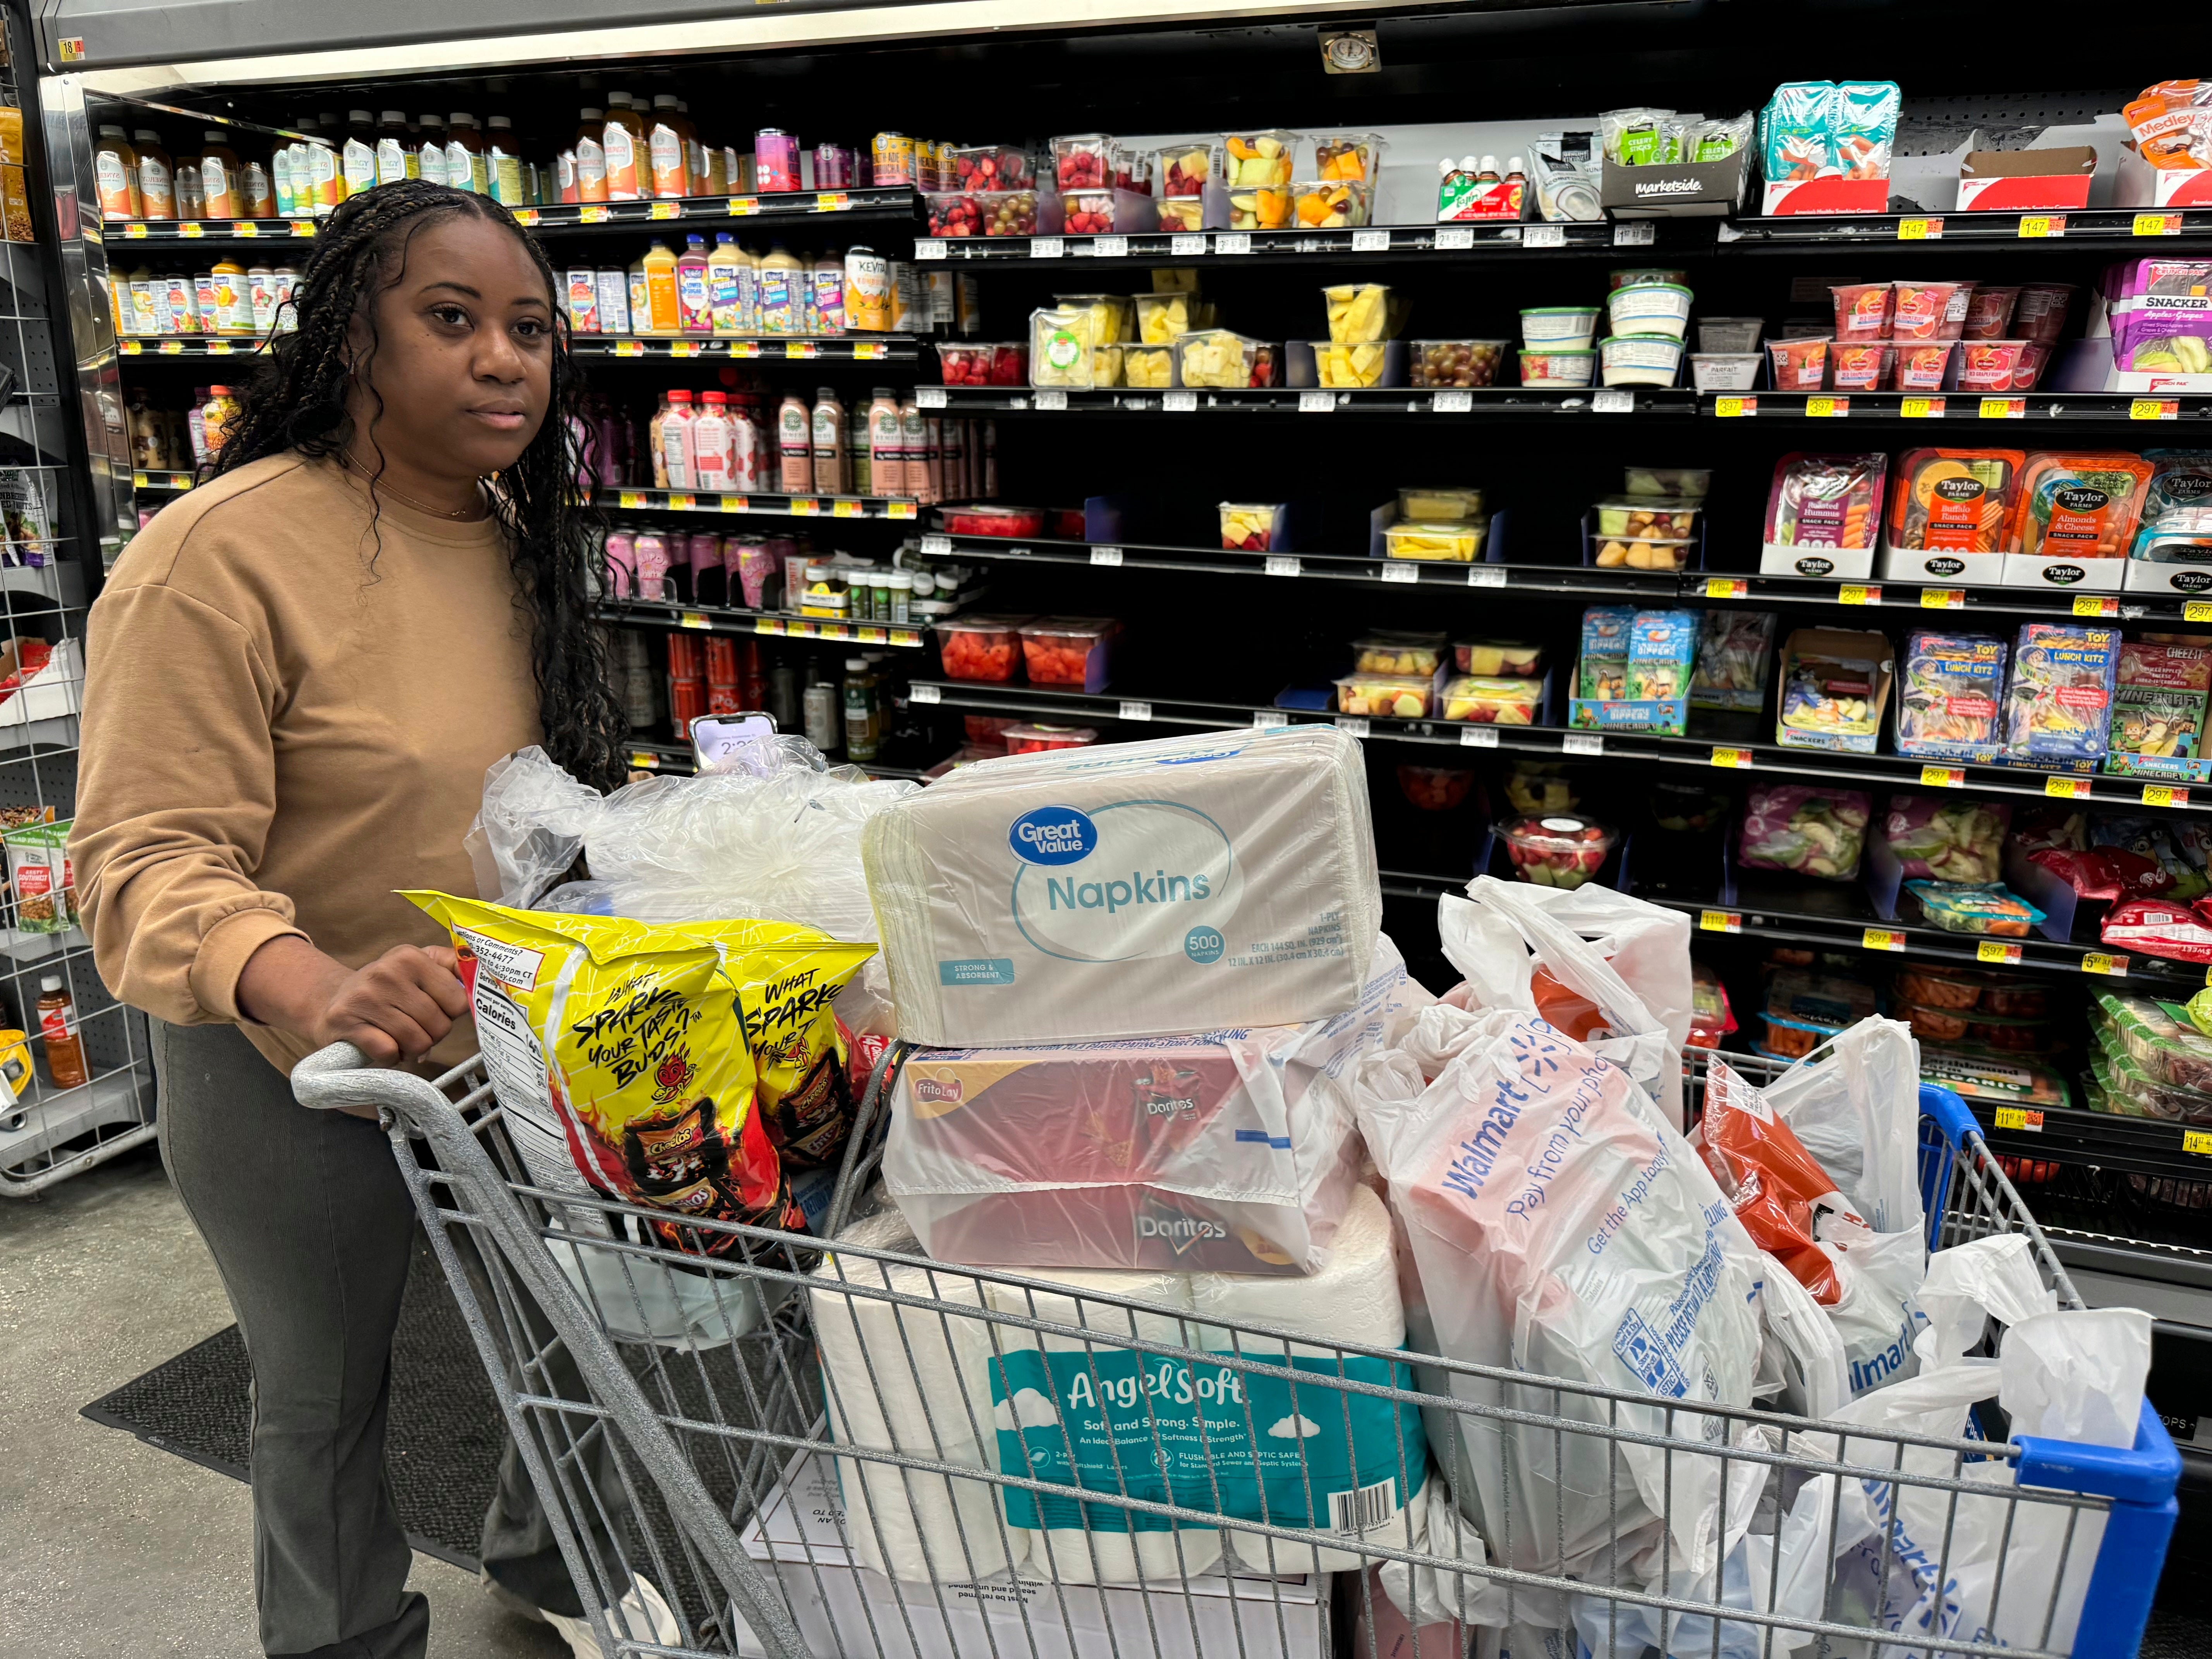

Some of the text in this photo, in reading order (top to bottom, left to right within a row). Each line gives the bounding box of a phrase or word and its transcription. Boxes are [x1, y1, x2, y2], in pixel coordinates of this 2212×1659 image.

[63, 41, 72, 53] 18
[2138, 113, 2196, 137] Medley
[1628, 137, 1653, 146] CELERY
[1630, 143, 1652, 151] STICKS
[1626, 155, 1635, 166] 4
[2146, 297, 2208, 308] SNACKER
[1941, 480, 1980, 491] Taylor
[2171, 479, 2211, 488] Taylor
[2064, 491, 2104, 503] Taylor
[1807, 501, 1839, 511] Roasted
[1941, 505, 1970, 514] Buffalo
[1804, 508, 1840, 518] Hummus
[1941, 513, 1968, 521] Ranch
[2057, 515, 2096, 523] Almonds
[2064, 523, 2095, 531] Cheese
[1800, 560, 1830, 570] Taylor
[1930, 560, 1962, 570] Taylor
[2049, 567, 2081, 577] Taylor
[2177, 575, 2212, 584] Taylor
[2086, 632, 2110, 642] TOY
[1975, 644, 1998, 656] TOY
[2054, 652, 2104, 663] LUNCH KITZ
[1945, 663, 1993, 675] LUNCH KITZ
[2115, 689, 2203, 709] MINECRAFT
[1790, 735, 1825, 744] SNACKERS
[1017, 819, 1081, 844] Great
[1034, 837, 1083, 854] Value
[1047, 869, 1212, 914] Napkins
[1319, 911, 1340, 922] 1-PLY
[1308, 922, 1341, 936] NAPKINS
[484, 939, 523, 956] Comments?
[1189, 935, 1219, 950] 500
[1252, 943, 1269, 953] EACH
[1270, 942, 1285, 952] 144
[1296, 940, 1308, 948] IN.
[1309, 936, 1325, 947] (929
[1228, 957, 1237, 967] 12
[1237, 956, 1248, 966] IN.
[1249, 956, 1254, 965] X
[1255, 955, 1264, 965] 12
[1264, 954, 1276, 963] IN.
[1307, 950, 1313, 958] X
[488, 958, 494, 966] to
[495, 962, 521, 976] 4:30pm
[954, 965, 984, 973] STRONG
[955, 972, 1000, 980] ABSORBENT
[765, 968, 821, 1004] WHAT
[476, 998, 516, 1030] Calories
[572, 987, 682, 1049] SPARKS
[861, 1035, 883, 1046] 14
[589, 1037, 638, 1069] YOUR
[611, 1008, 690, 1090] BUDS?
[800, 1077, 828, 1110] Cheetos
[917, 1084, 959, 1099] Frito Lay
[1147, 1096, 1194, 1116] Doritos
[650, 1128, 692, 1155] Cheetos
[1441, 1079, 1529, 1200] Walmart
[1506, 1091, 1594, 1221] Pay from your
[1588, 1228, 1611, 1255] Get
[1604, 1206, 1628, 1233] the
[1621, 1180, 1649, 1209] App
[1139, 1215, 1227, 1241] Doritos
[1665, 1319, 1691, 1352] PLEASE
[1067, 1362, 1245, 1408] Angel Soft
[1114, 1420, 1139, 1431] and
[1114, 1436, 1148, 1445] Balance
[1162, 1434, 1197, 1442] Softness
